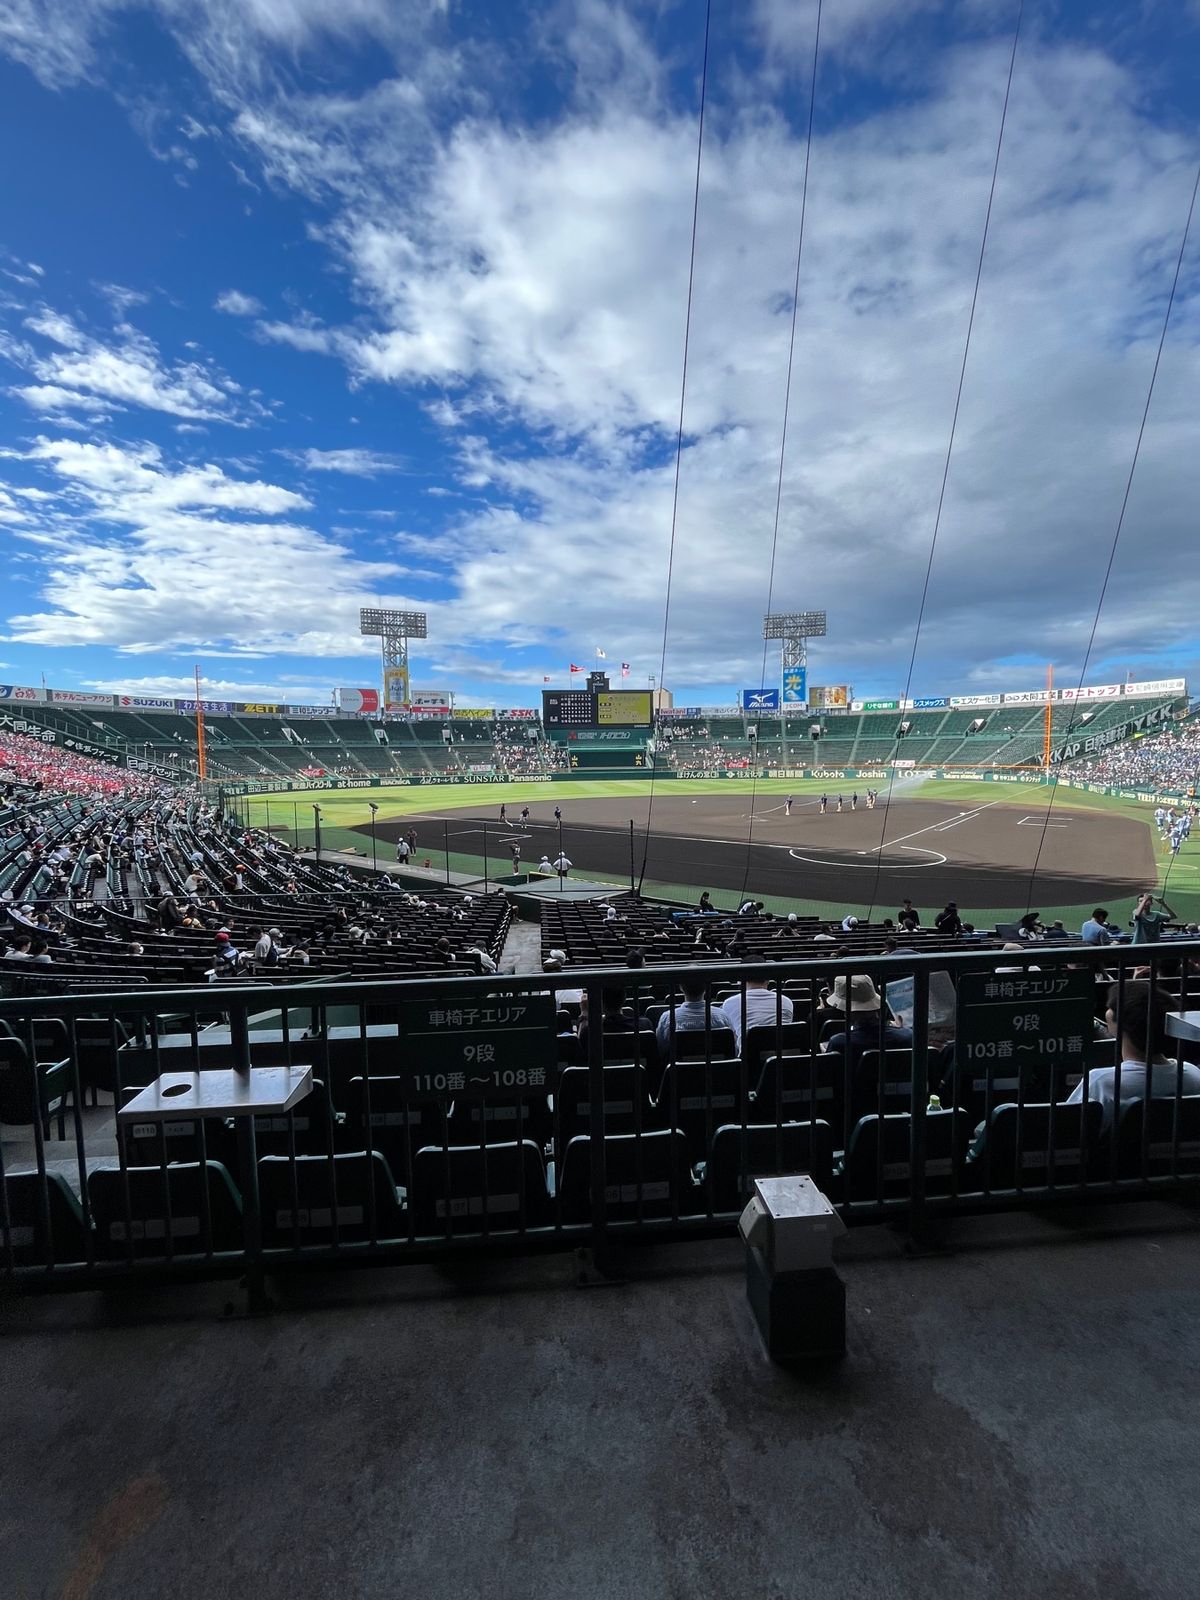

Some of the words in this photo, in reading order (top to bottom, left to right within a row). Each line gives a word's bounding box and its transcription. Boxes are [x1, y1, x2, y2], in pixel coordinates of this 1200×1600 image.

[785, 675, 802, 690] 光
[1065, 686, 1118, 698] カニトップ
[133, 699, 173, 708] SUZUKI
[914, 699, 946, 708] シスメックス
[961, 695, 999, 705] エスケー化研
[244, 704, 279, 713] ZETT
[510, 709, 533, 717] SSK
[1135, 704, 1172, 731] YKK
[0, 715, 56, 742] 大同生命
[1085, 725, 1127, 752] 日鉄建材
[508, 774, 552, 783] Panasonic
[677, 770, 716, 778] ほけんの窓口
[768, 770, 804, 778] 朝日新聞
[811, 770, 845, 778] Kubota
[856, 770, 887, 778] Joshin
[463, 775, 505, 783] SUNSTAR
[983, 979, 1070, 998] 車椅子エリア
[428, 1006, 527, 1027] 車椅子エリア
[1012, 1014, 1041, 1032] 9段
[463, 1044, 496, 1063] 9段
